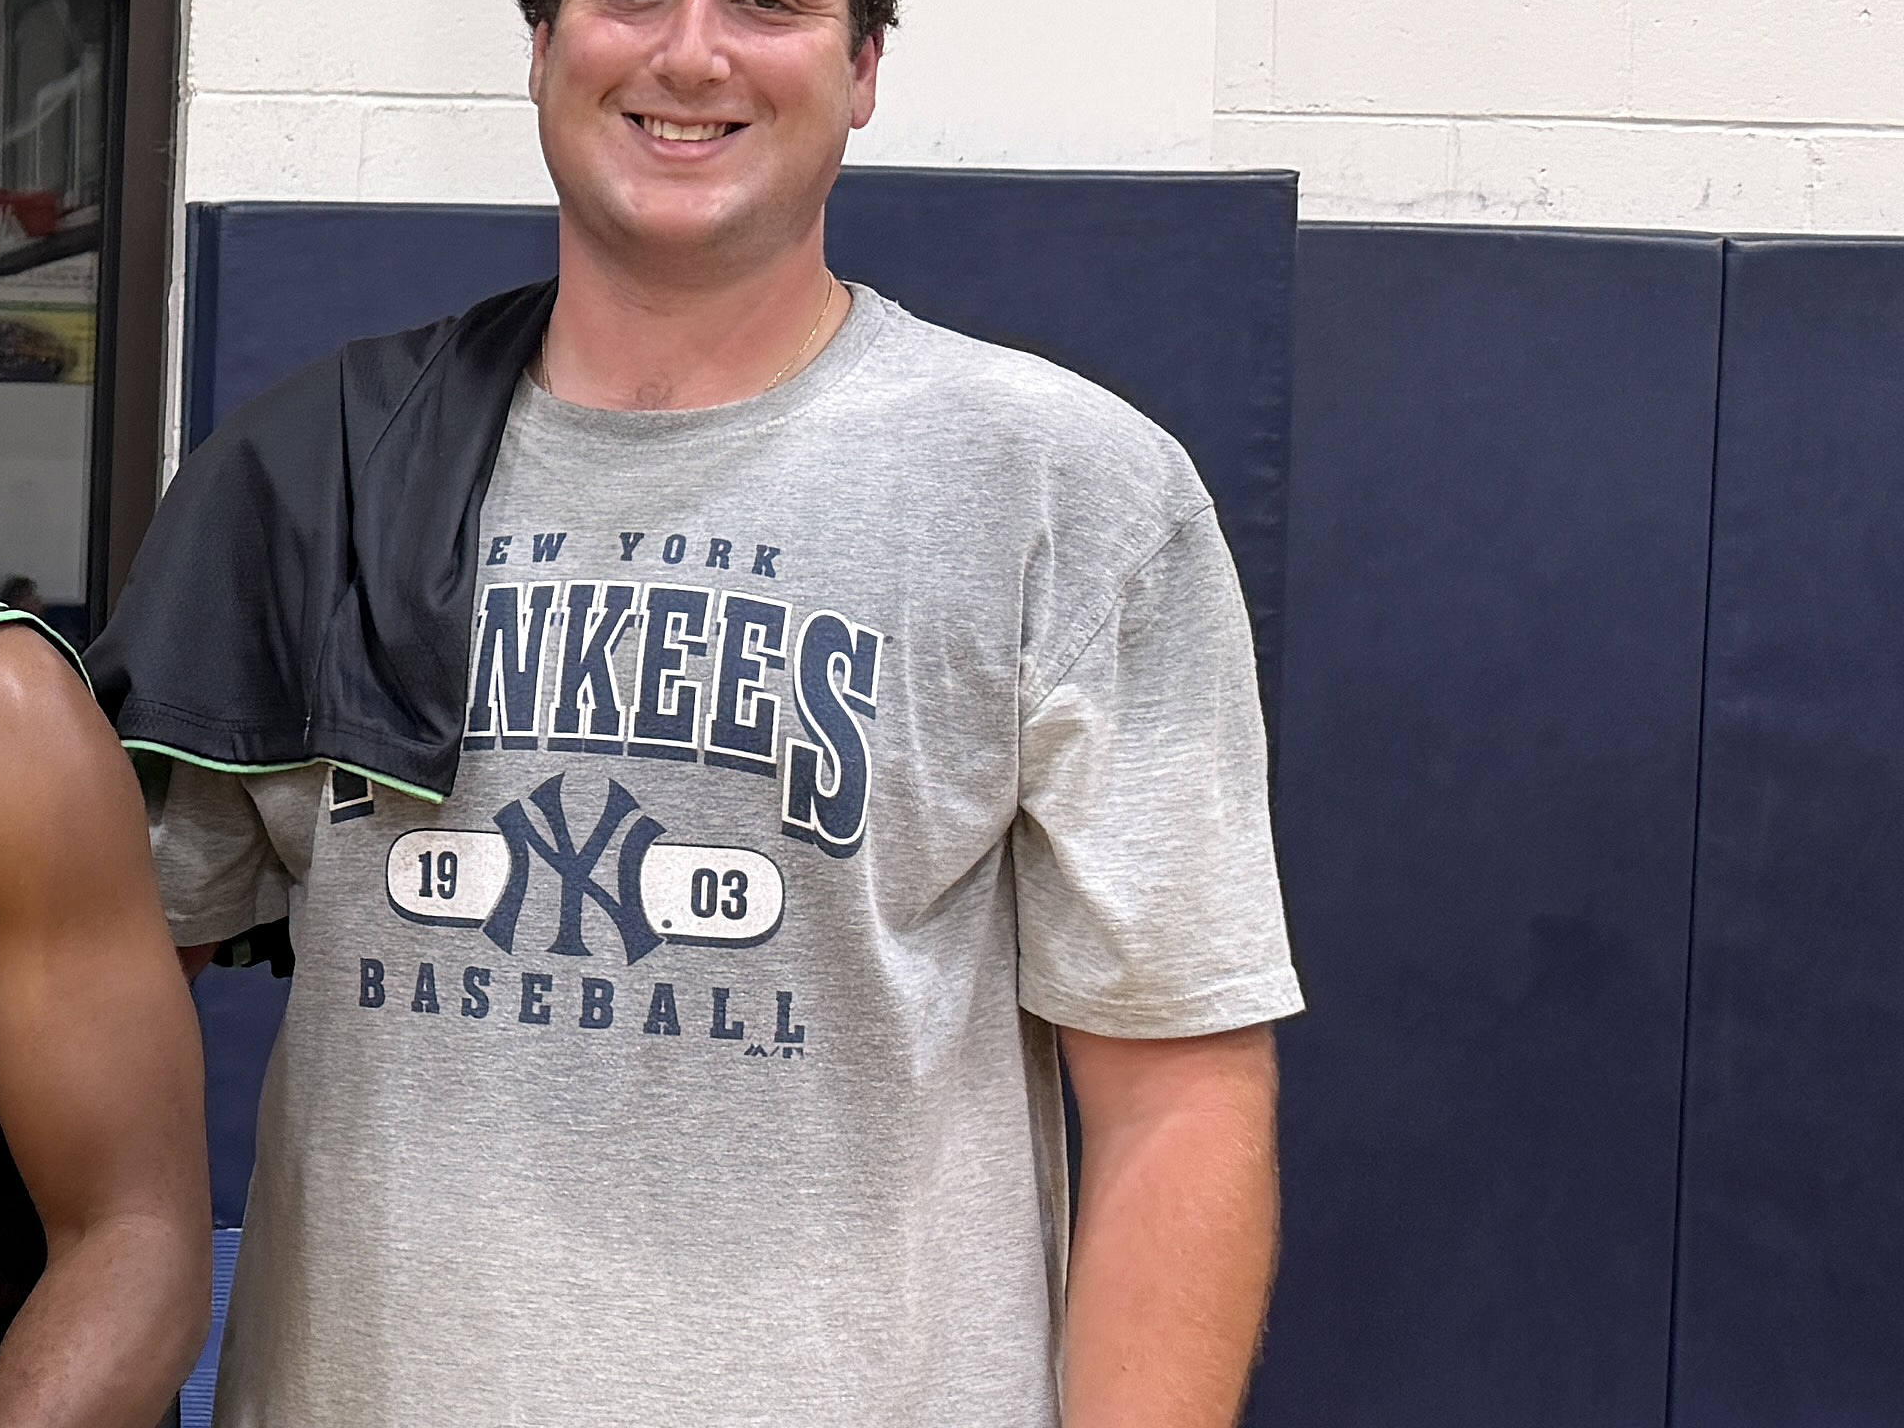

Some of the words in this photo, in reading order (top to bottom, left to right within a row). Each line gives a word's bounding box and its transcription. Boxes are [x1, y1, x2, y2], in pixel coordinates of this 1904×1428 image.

[486, 532, 568, 567] EW
[618, 532, 782, 579] YORK
[463, 579, 884, 859] NKEES
[417, 850, 459, 900] 19
[690, 867, 749, 921] 03
[359, 957, 806, 1045] BASEBALL
